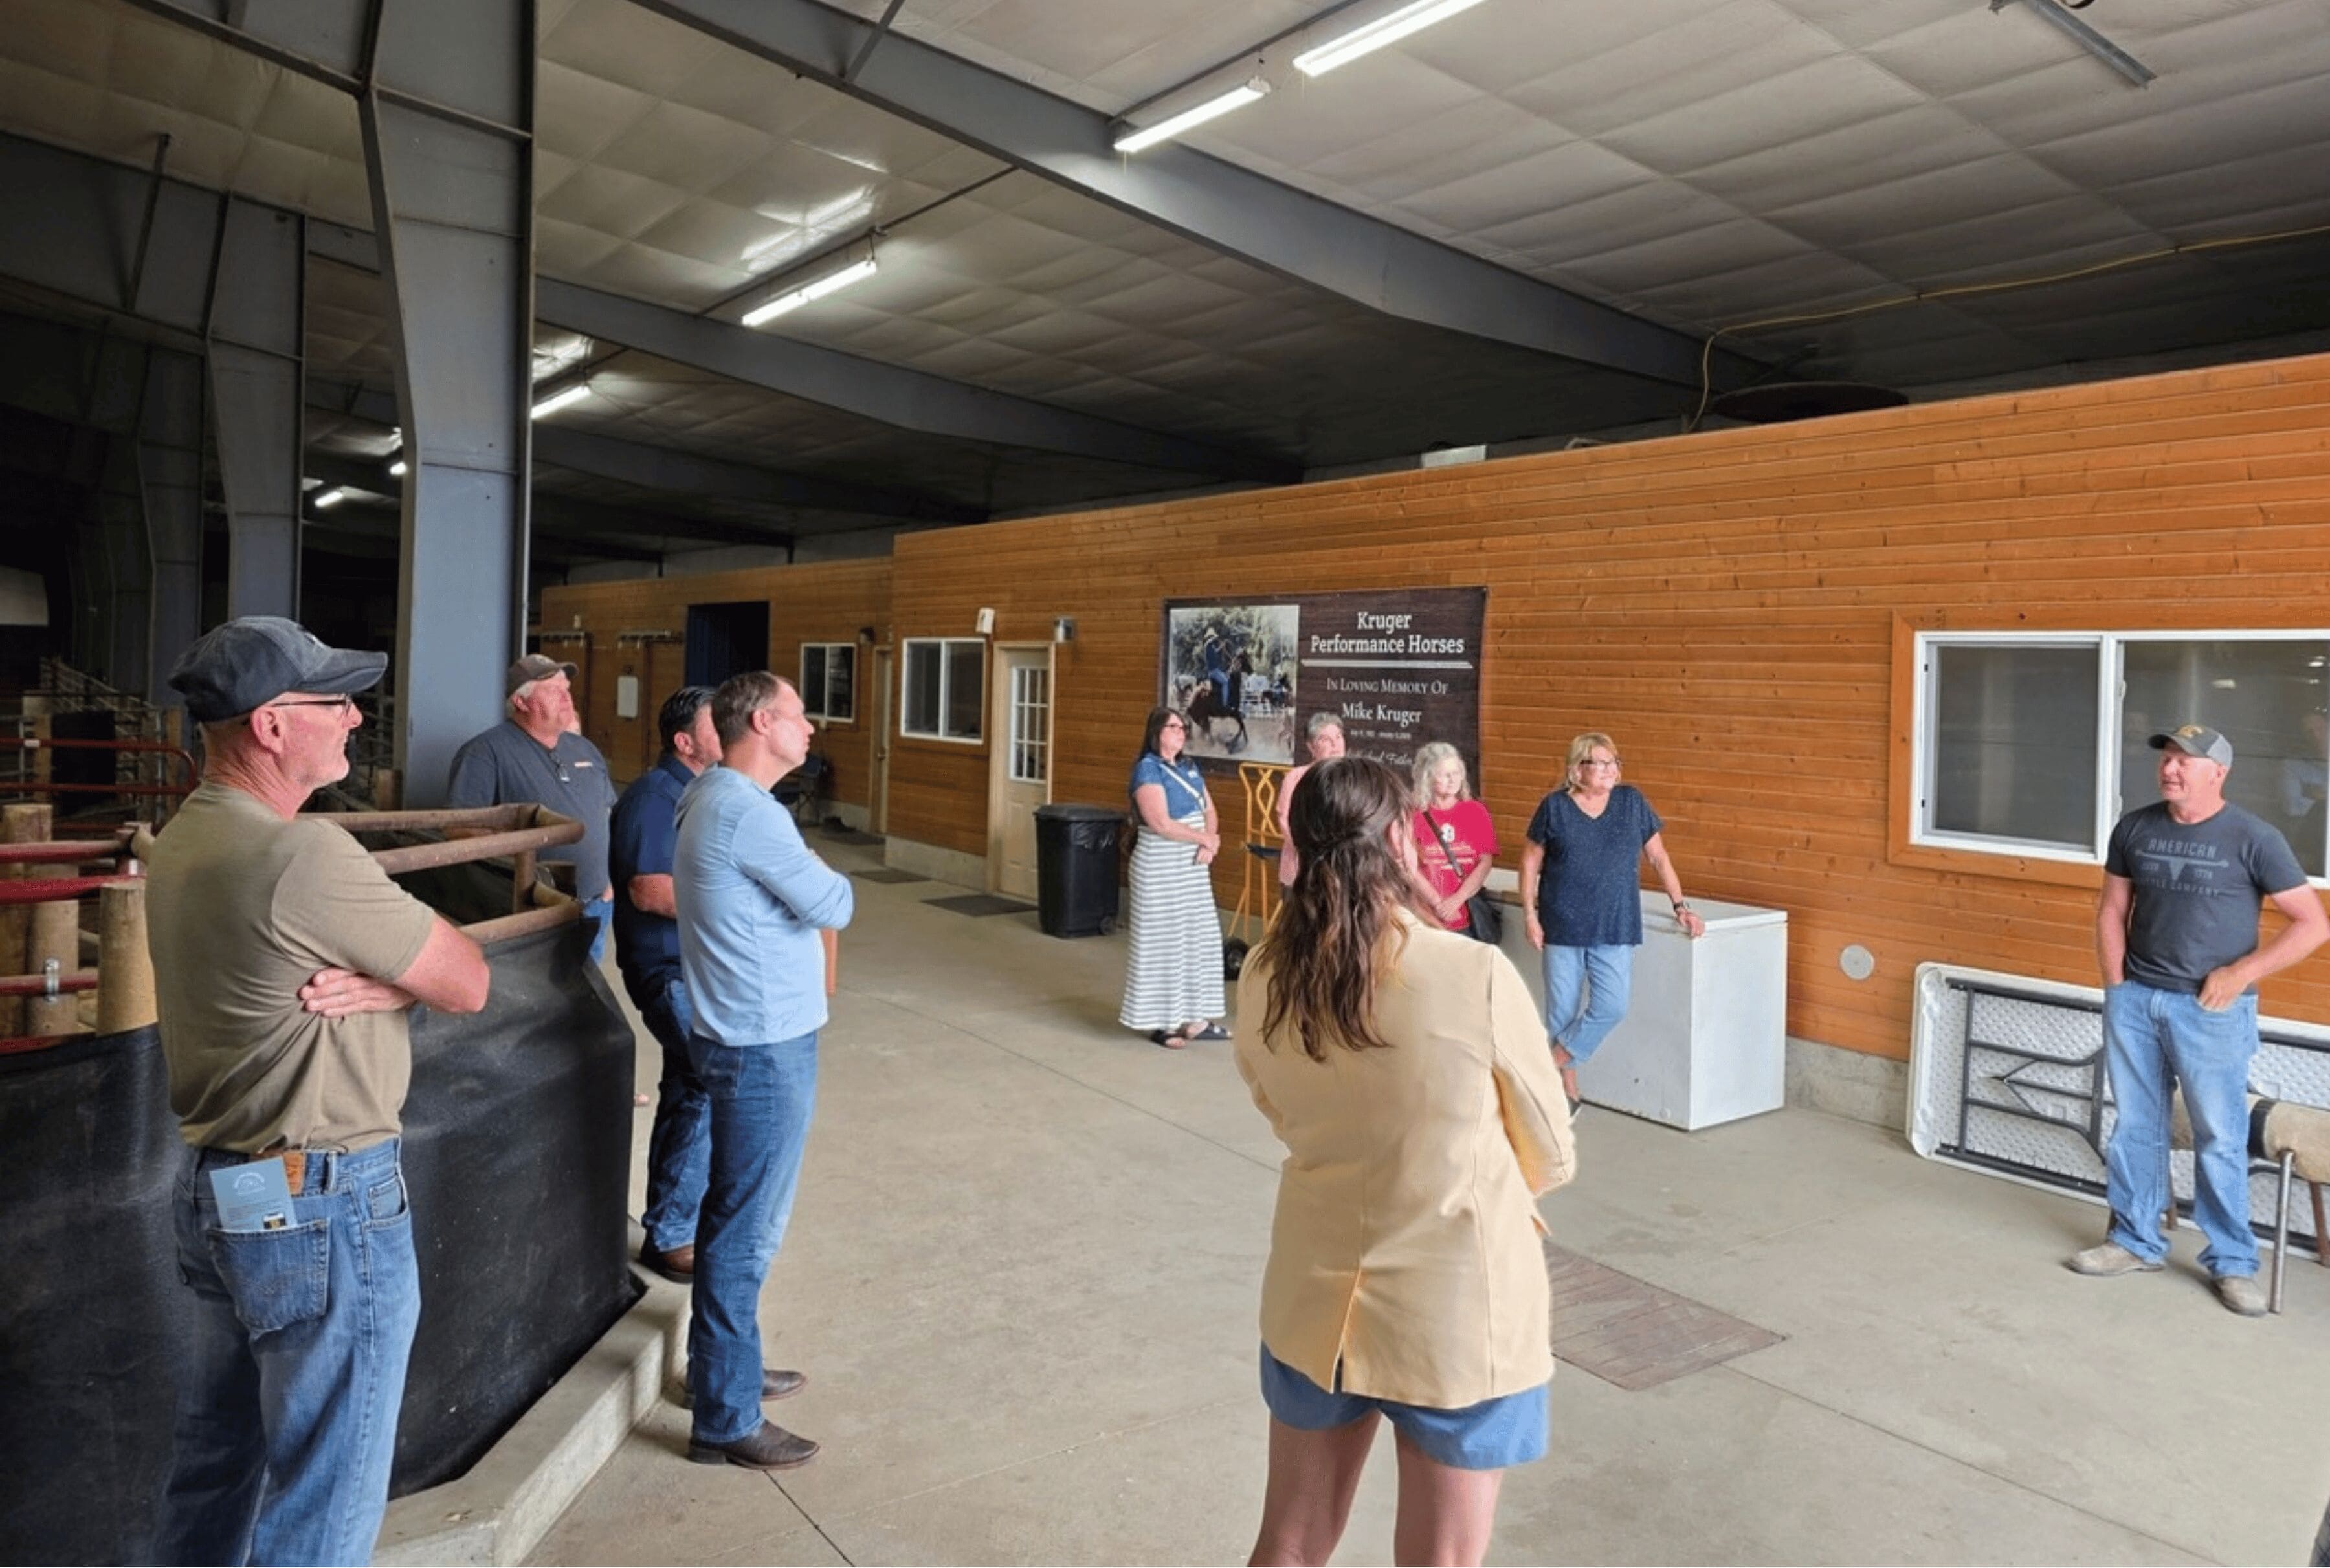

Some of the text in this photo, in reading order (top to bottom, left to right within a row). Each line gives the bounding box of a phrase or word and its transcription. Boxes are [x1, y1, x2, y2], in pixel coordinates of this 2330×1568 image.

[1357, 611, 1412, 634] Kruger
[1311, 633, 1465, 654] Performance Horses
[1341, 701, 1423, 728] Mike Kruger
[2148, 839, 2217, 859] AMERICAN
